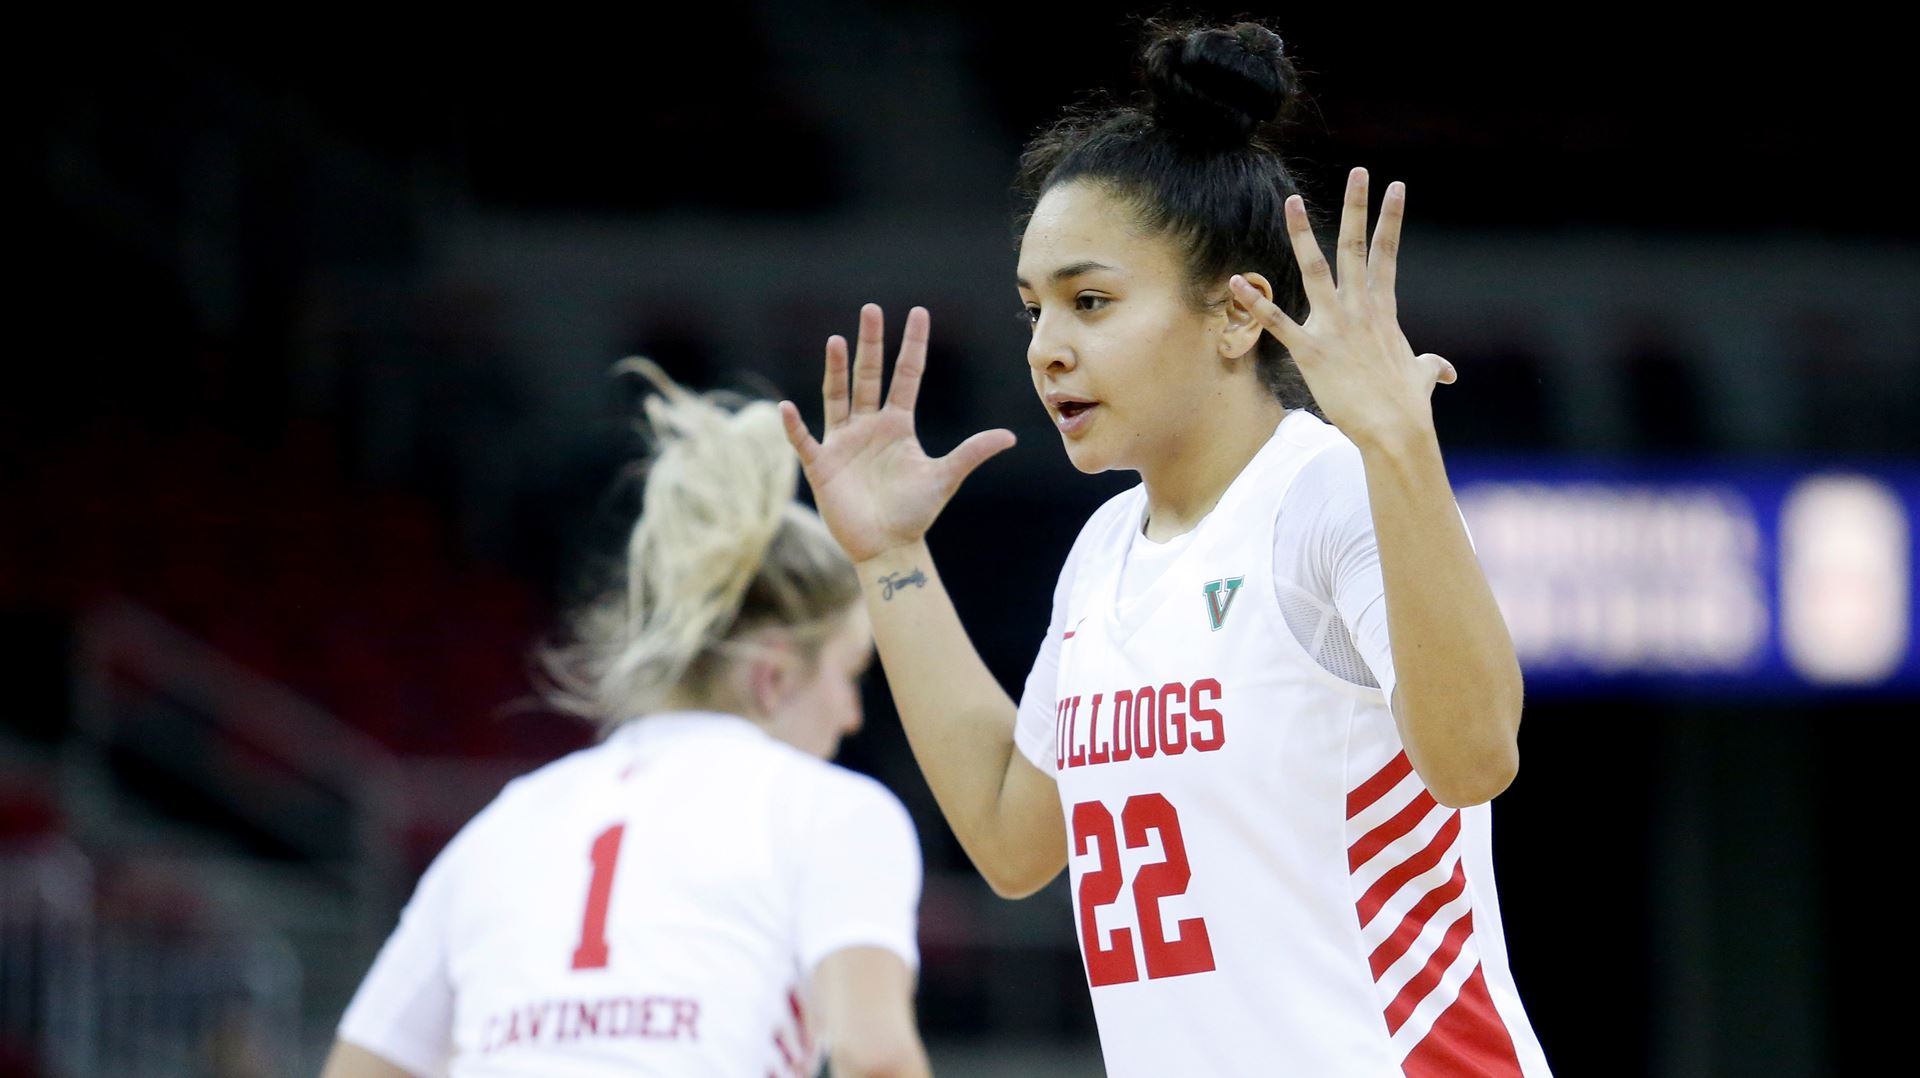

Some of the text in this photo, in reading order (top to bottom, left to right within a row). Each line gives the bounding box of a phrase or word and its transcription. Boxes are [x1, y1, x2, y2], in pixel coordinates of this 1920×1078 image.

[1204, 575, 1245, 632] V
[1056, 678, 1225, 771] ULLDOGS
[572, 824, 625, 969] 1
[1073, 793, 1215, 986] 22
